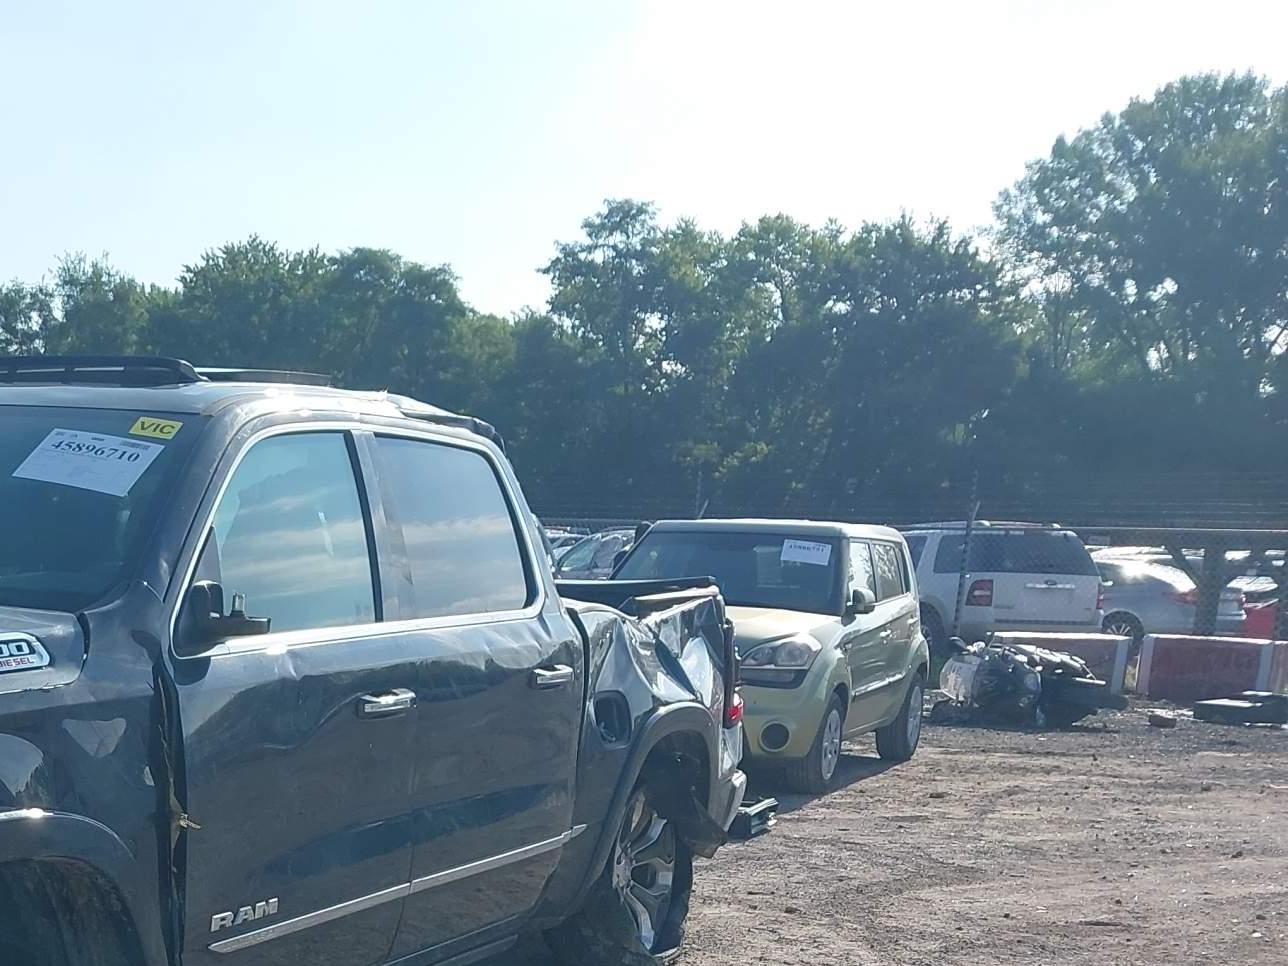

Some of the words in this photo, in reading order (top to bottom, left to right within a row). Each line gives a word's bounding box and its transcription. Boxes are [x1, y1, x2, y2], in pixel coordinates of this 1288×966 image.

[139, 420, 175, 435] VIC
[51, 440, 140, 462] 45896710
[210, 897, 278, 932] RAM
